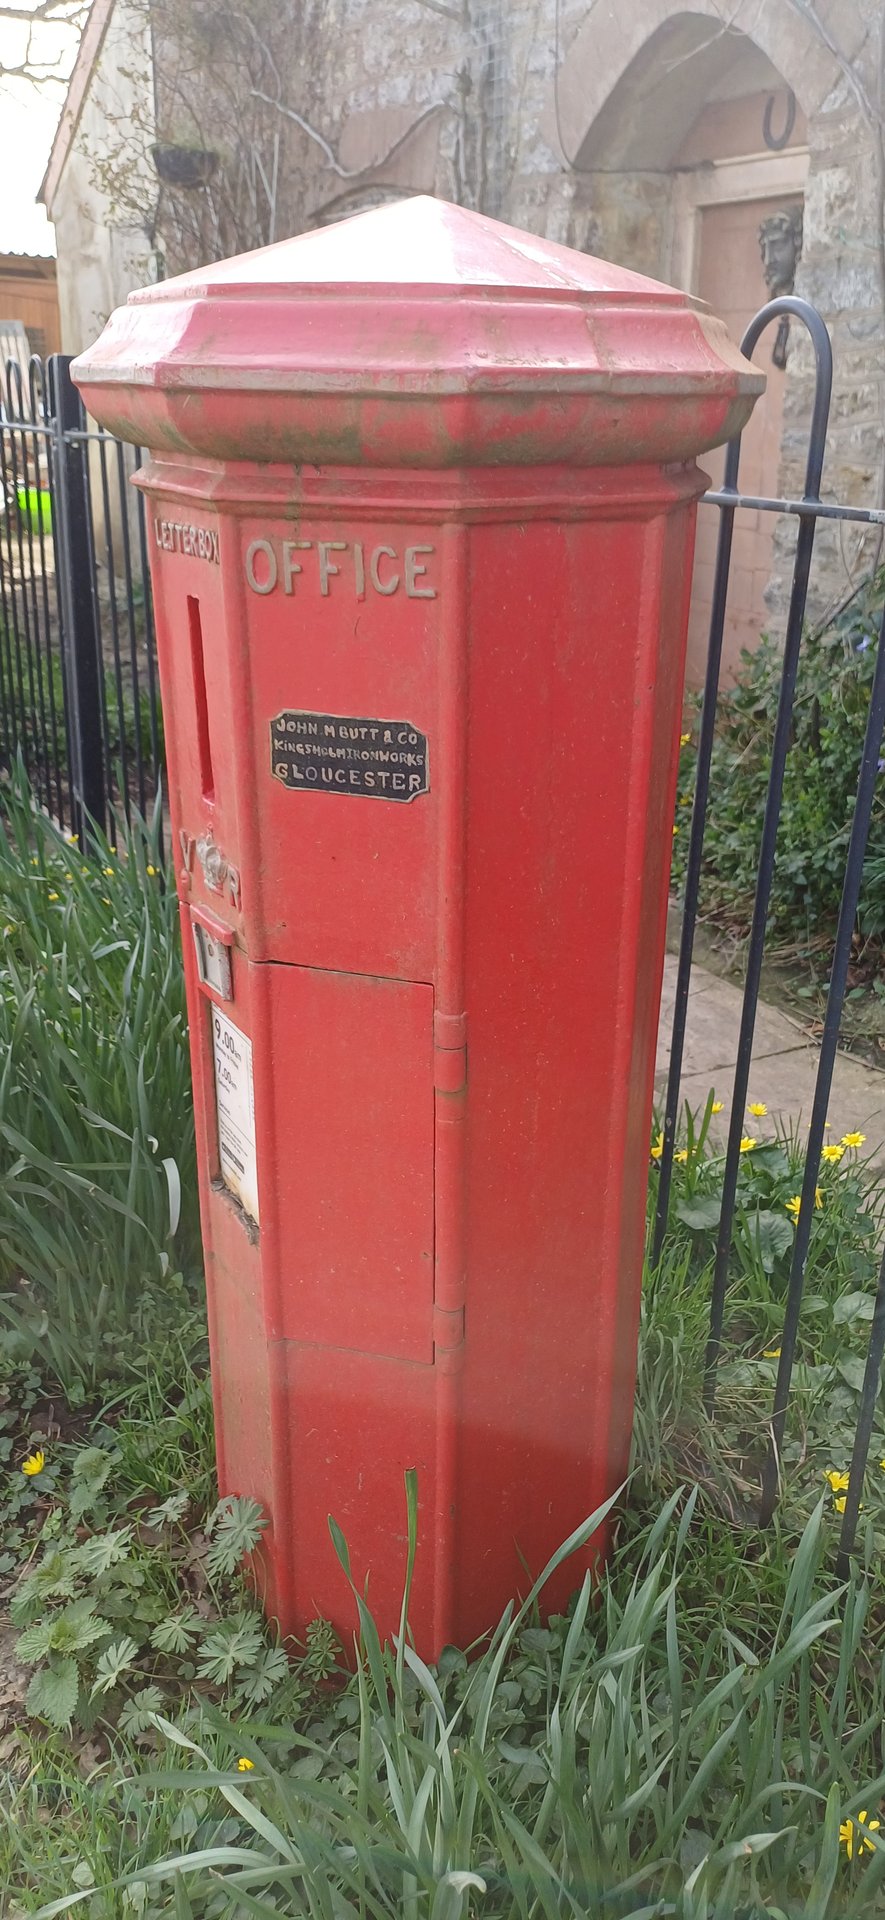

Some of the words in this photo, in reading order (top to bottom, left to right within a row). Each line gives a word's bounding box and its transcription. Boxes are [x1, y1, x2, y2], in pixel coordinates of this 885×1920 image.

[245, 539, 437, 600] OFFICE
[276, 718, 318, 736] JOHN
[324, 725, 335, 738] M
[339, 726, 379, 740] BUTT
[383, 730, 393, 744] &
[397, 732, 418, 745] CO
[274, 763, 421, 791] GLOUCESTER
